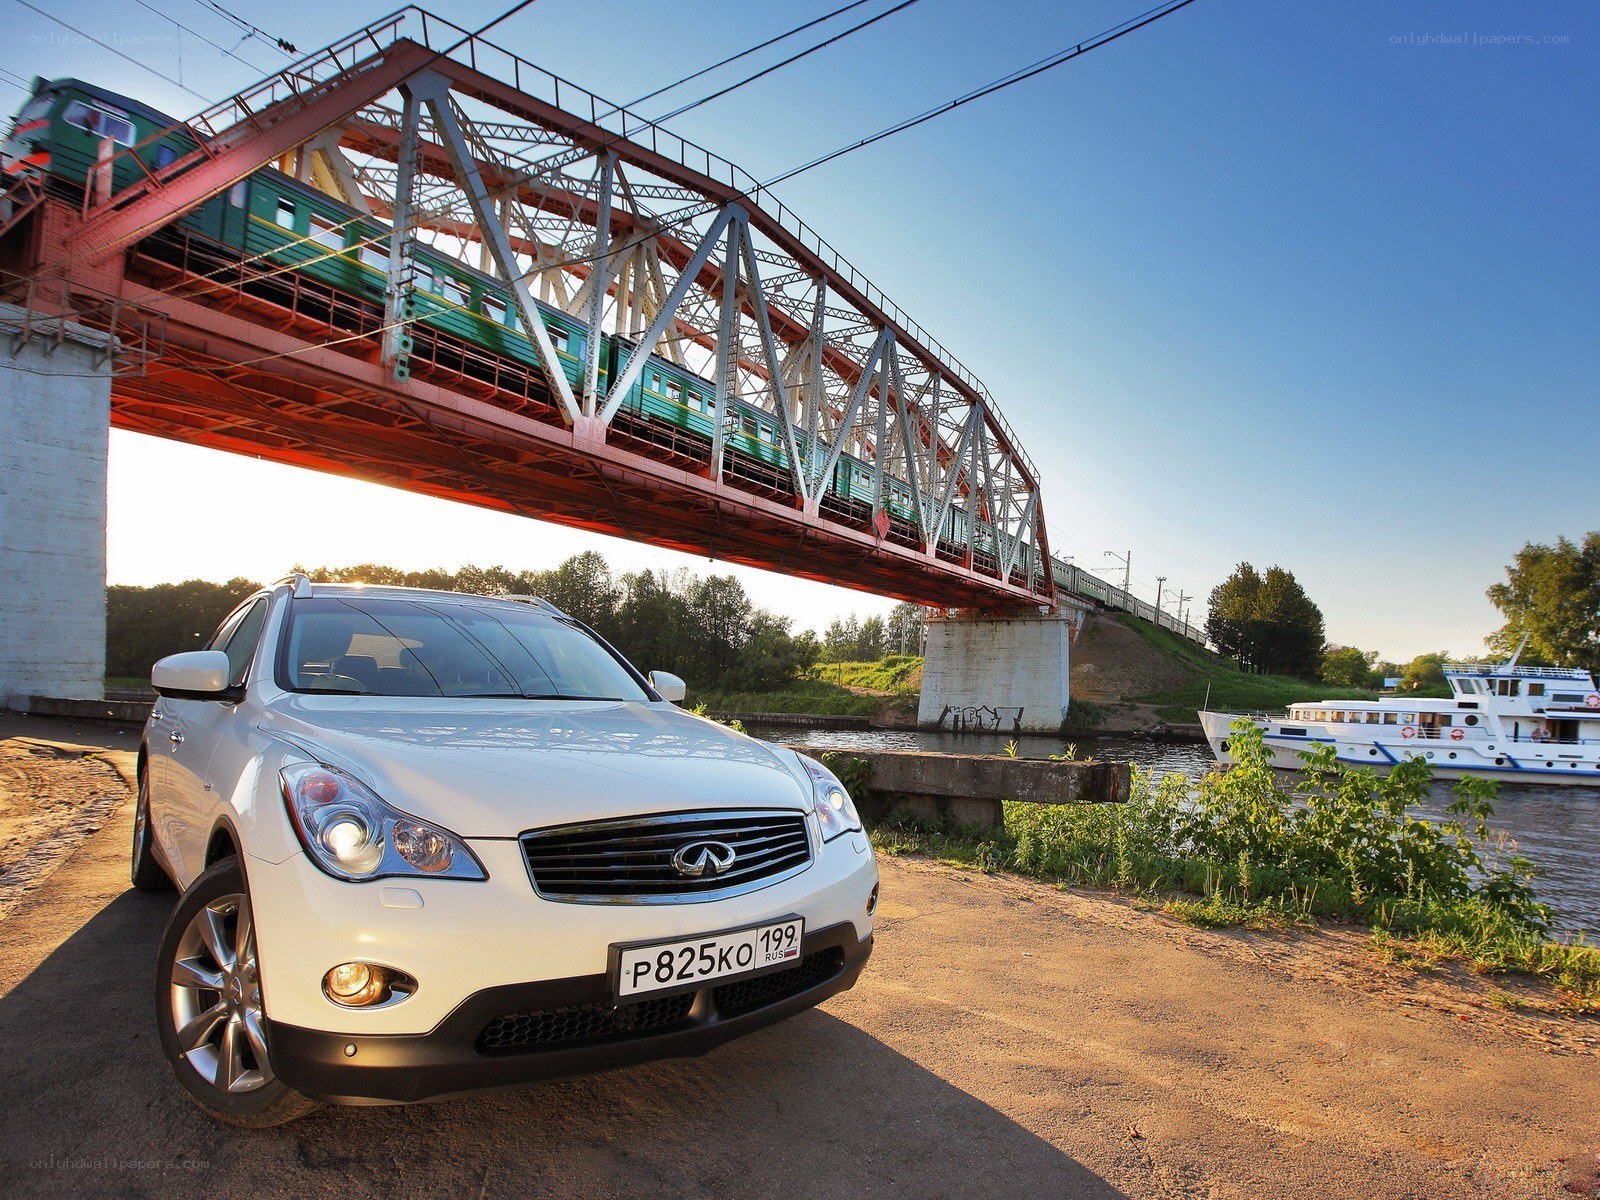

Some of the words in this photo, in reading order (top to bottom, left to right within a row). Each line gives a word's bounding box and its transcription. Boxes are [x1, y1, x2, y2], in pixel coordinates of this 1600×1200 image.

[632, 942, 752, 988] P825KO
[759, 924, 796, 953] 199
[765, 951, 784, 963] RUS
